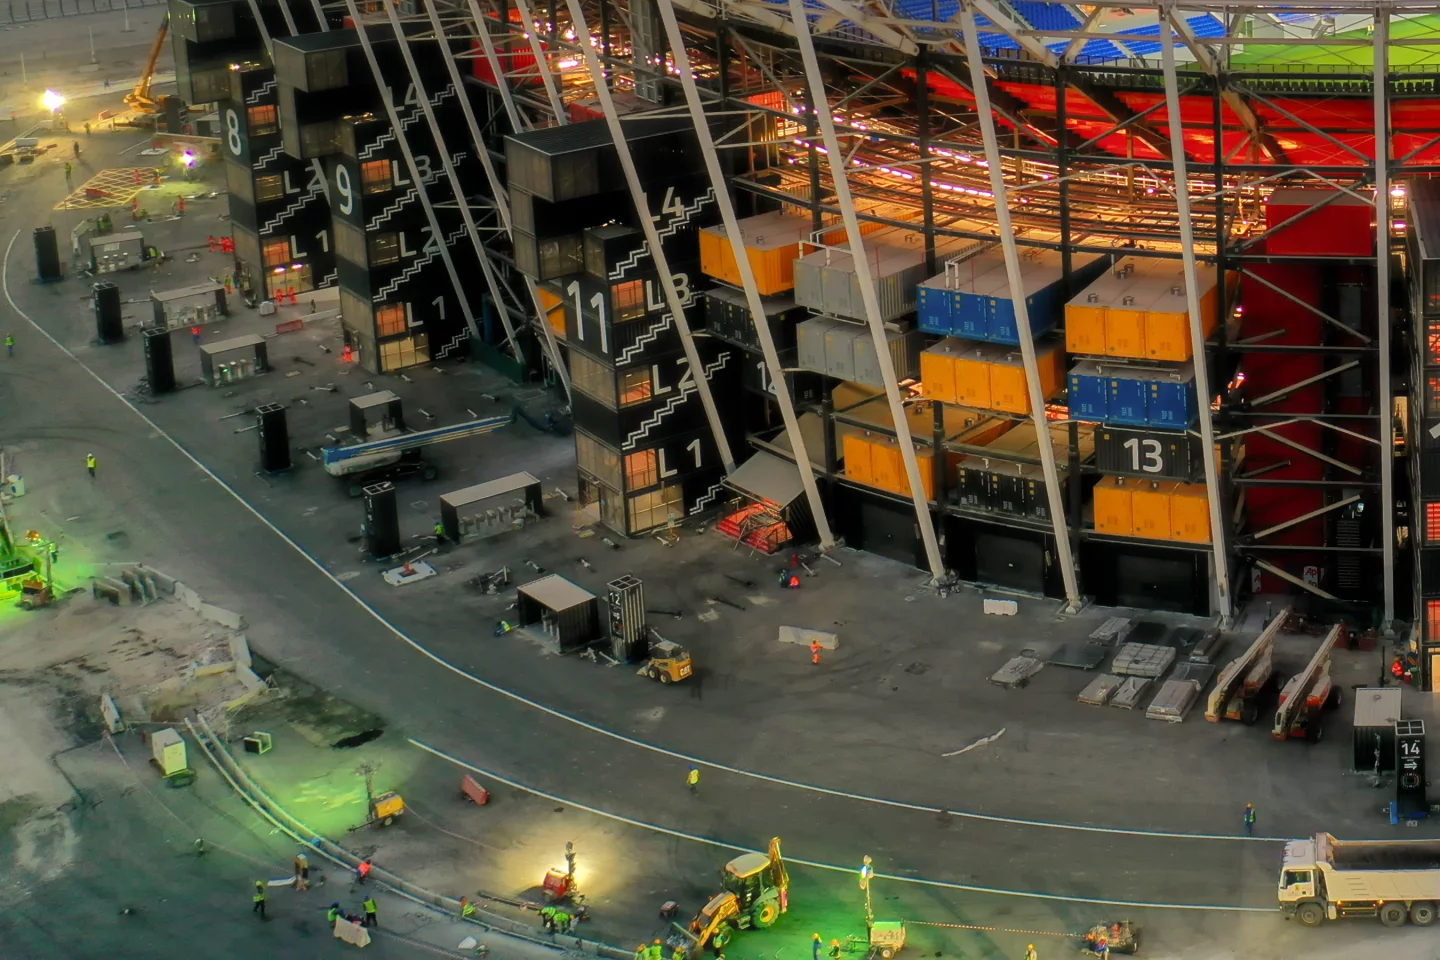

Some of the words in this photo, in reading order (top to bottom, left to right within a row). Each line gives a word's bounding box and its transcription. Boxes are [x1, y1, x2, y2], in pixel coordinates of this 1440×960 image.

[226, 109, 241, 155] 8
[336, 164, 352, 215] 9
[567, 280, 608, 354] 11
[1123, 438, 1163, 473] 13
[1401, 742, 1420, 755] 14
